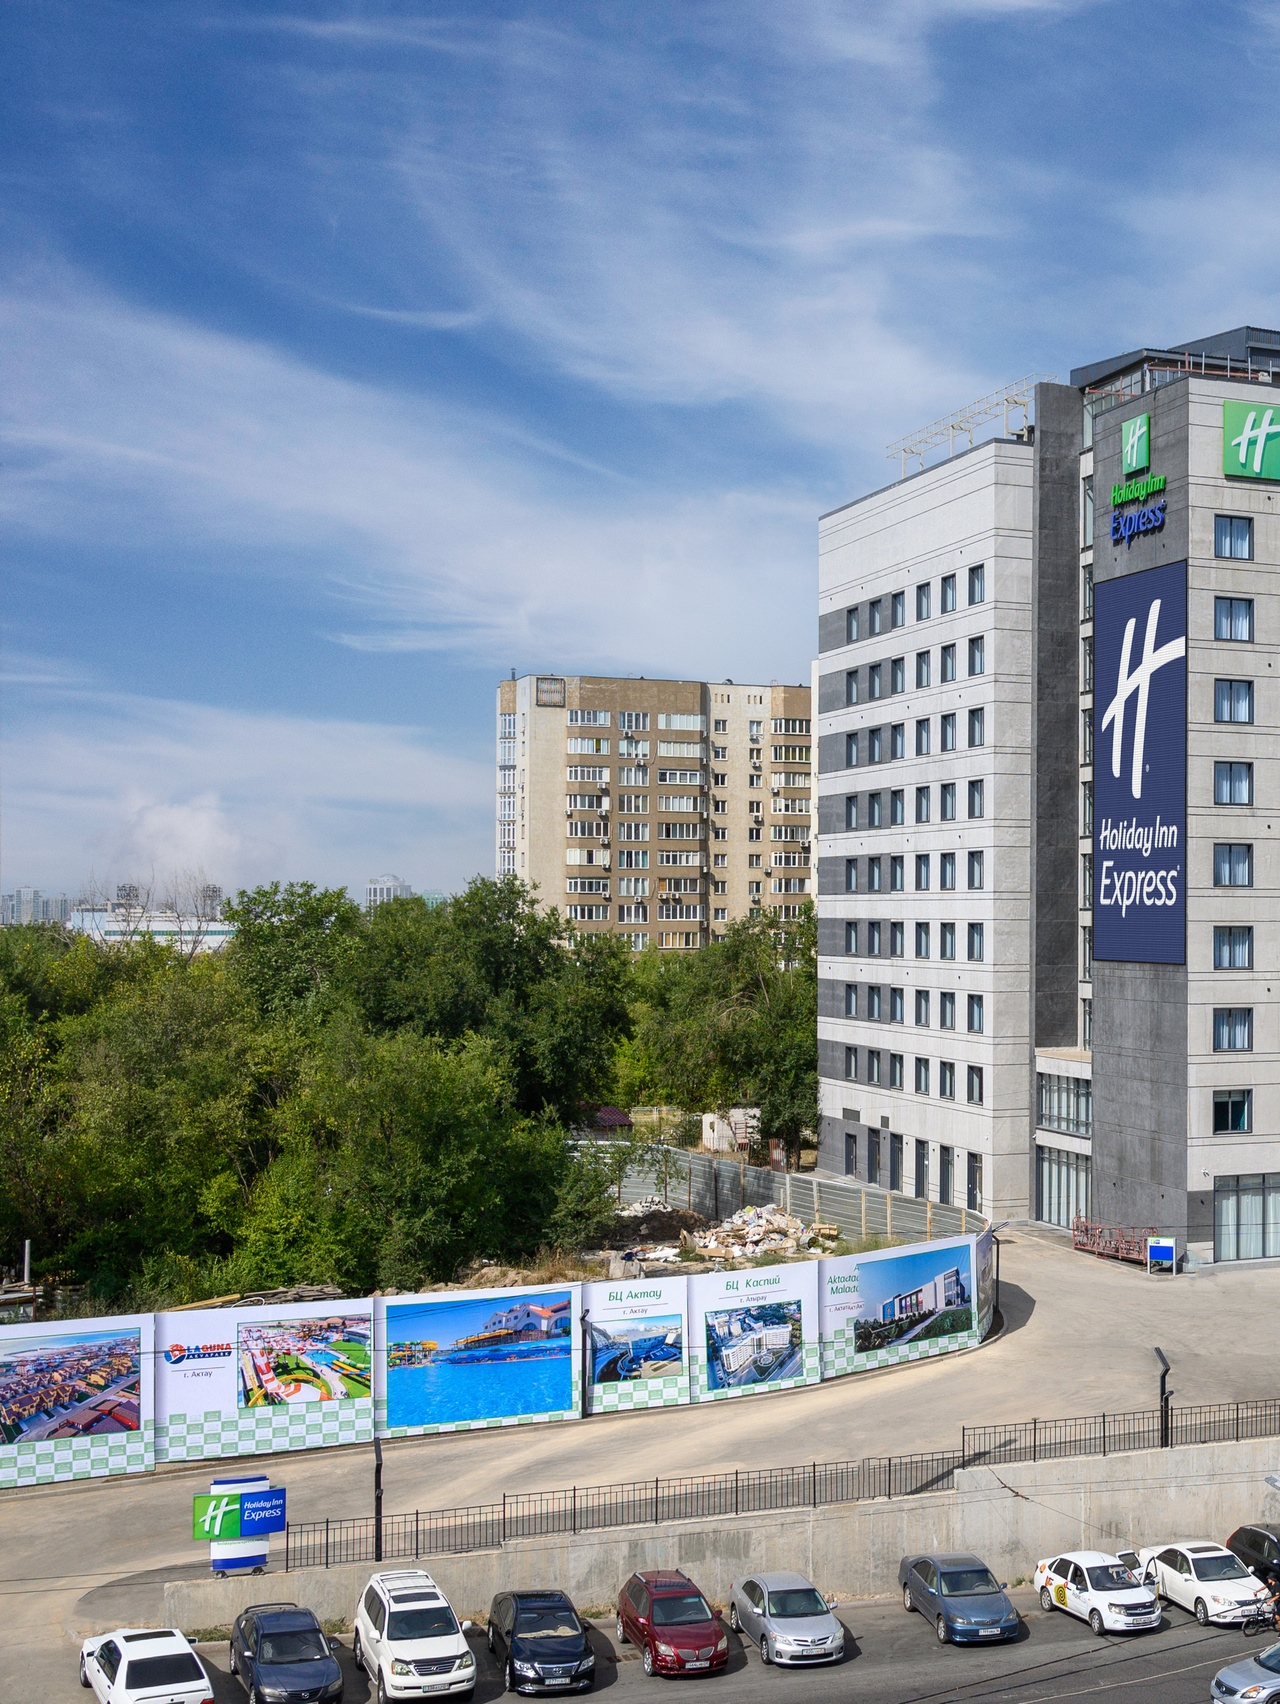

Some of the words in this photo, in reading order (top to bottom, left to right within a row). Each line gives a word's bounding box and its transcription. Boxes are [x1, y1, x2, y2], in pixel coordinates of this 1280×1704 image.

[1110, 478, 1148, 506] Holiday
[1147, 472, 1166, 494] Inn
[1110, 502, 1165, 544] Express
[1099, 817, 1154, 857] Holiday
[1154, 815, 1178, 849] Inn
[1099, 860, 1178, 918] Express
[725, 1281, 739, 1291] БЦ
[745, 1275, 781, 1288] Каспий
[608, 1291, 623, 1302] БЦ
[626, 1290, 662, 1300] Актау
[746, 1295, 767, 1303] Атырау
[187, 1343, 232, 1353] LAGUNA
[244, 1500, 272, 1509] Holiday
[272, 1498, 283, 1506] Inn
[244, 1508, 281, 1521] Express
